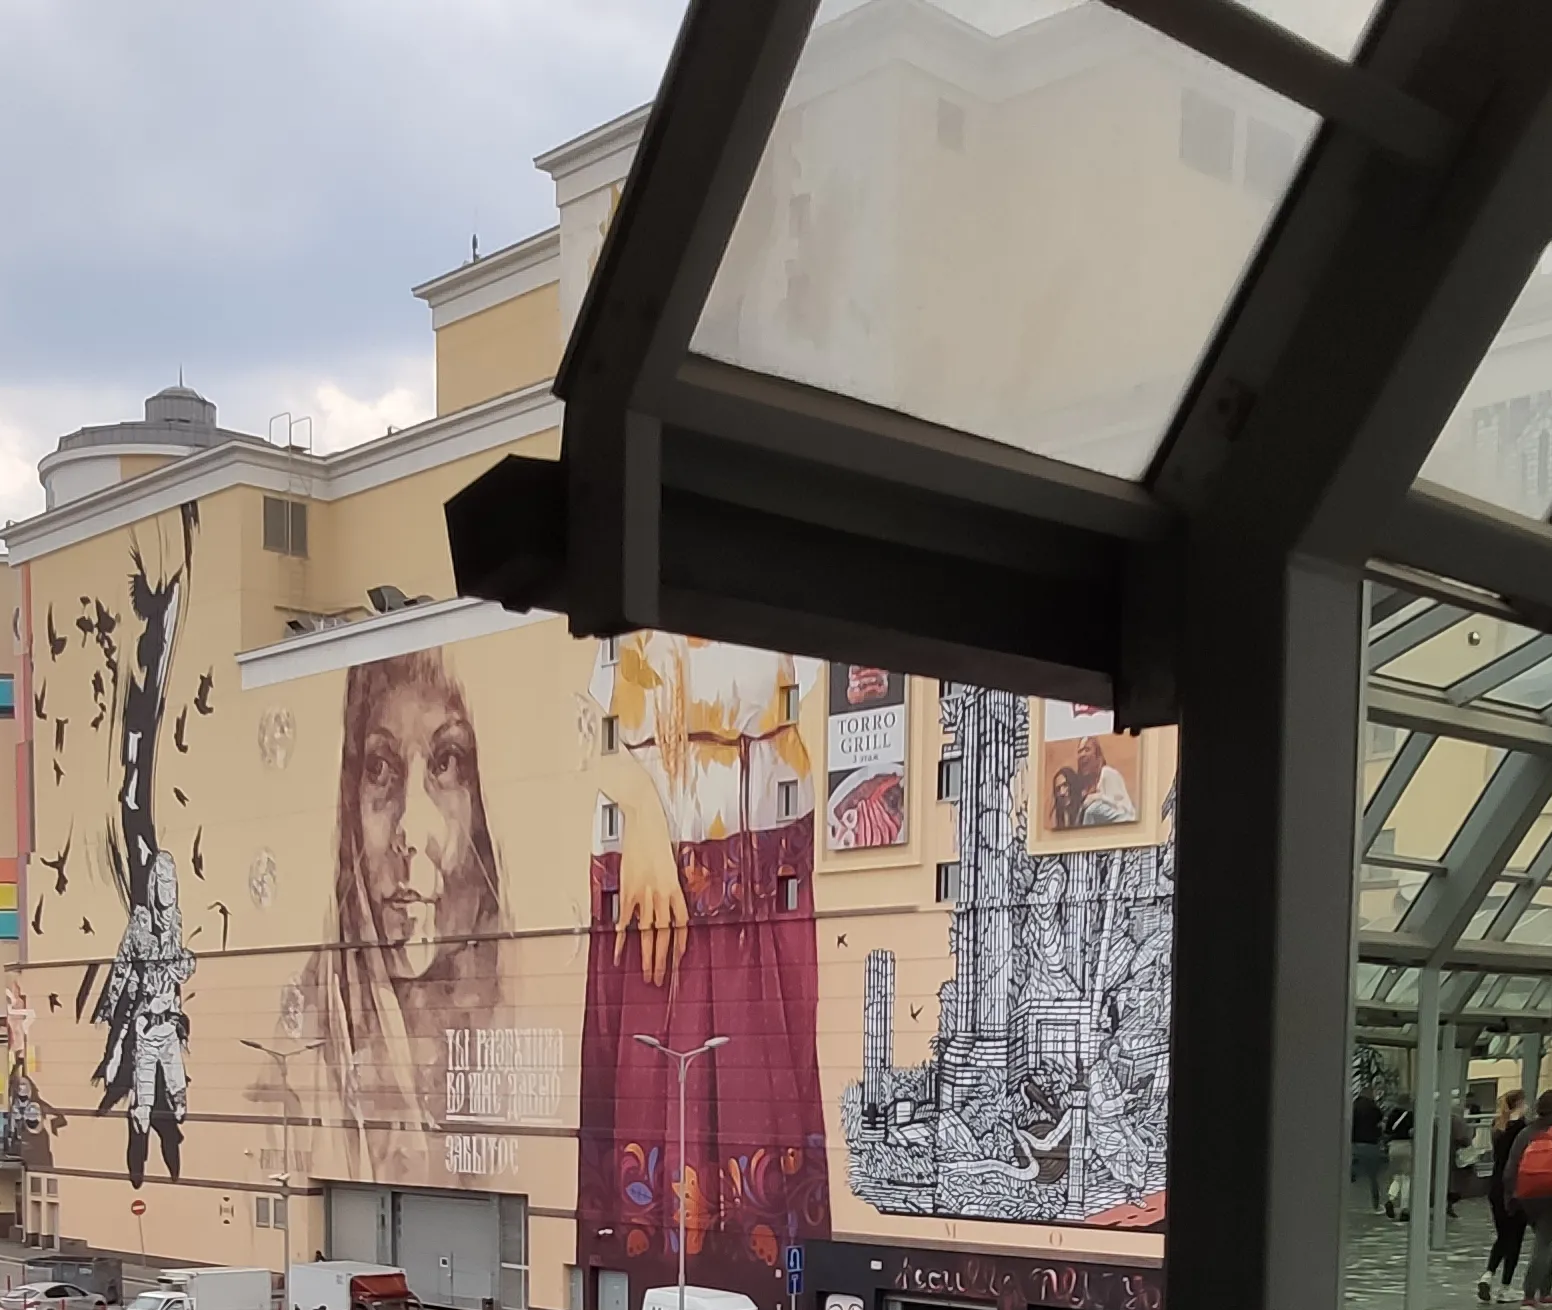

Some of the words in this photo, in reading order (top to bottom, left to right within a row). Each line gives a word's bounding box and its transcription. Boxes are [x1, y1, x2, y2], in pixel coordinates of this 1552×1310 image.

[838, 712, 895, 734] TORRO
[841, 733, 891, 753] GRILL
[445, 1028, 470, 1071] ТЫ
[446, 1072, 466, 1114] ВО
[445, 1135, 519, 1176] ЗАБЫТОЕ
